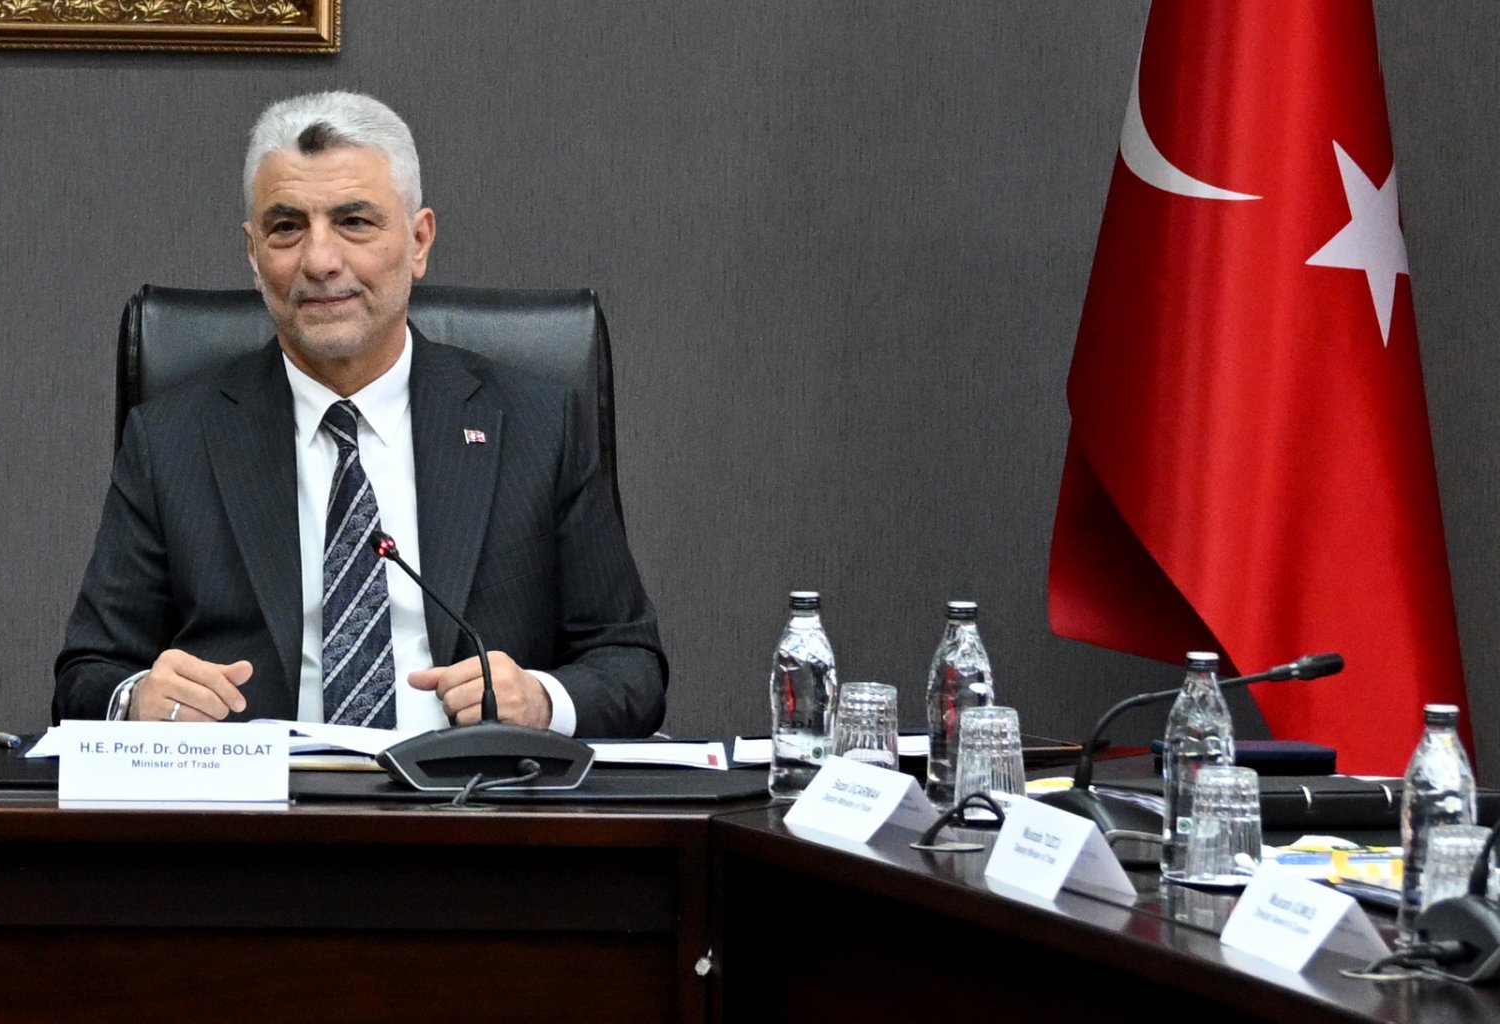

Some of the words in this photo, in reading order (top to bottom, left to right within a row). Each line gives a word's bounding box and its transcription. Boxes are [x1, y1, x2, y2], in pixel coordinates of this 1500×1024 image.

[80, 742, 109, 753] H.E.
[114, 742, 148, 754] Prof.
[153, 743, 173, 754] Dr.
[177, 741, 217, 755] Ömer
[222, 744, 273, 756] BOLAT
[131, 759, 174, 768] Minister
[177, 760, 188, 768] of
[191, 760, 220, 769] Trade
